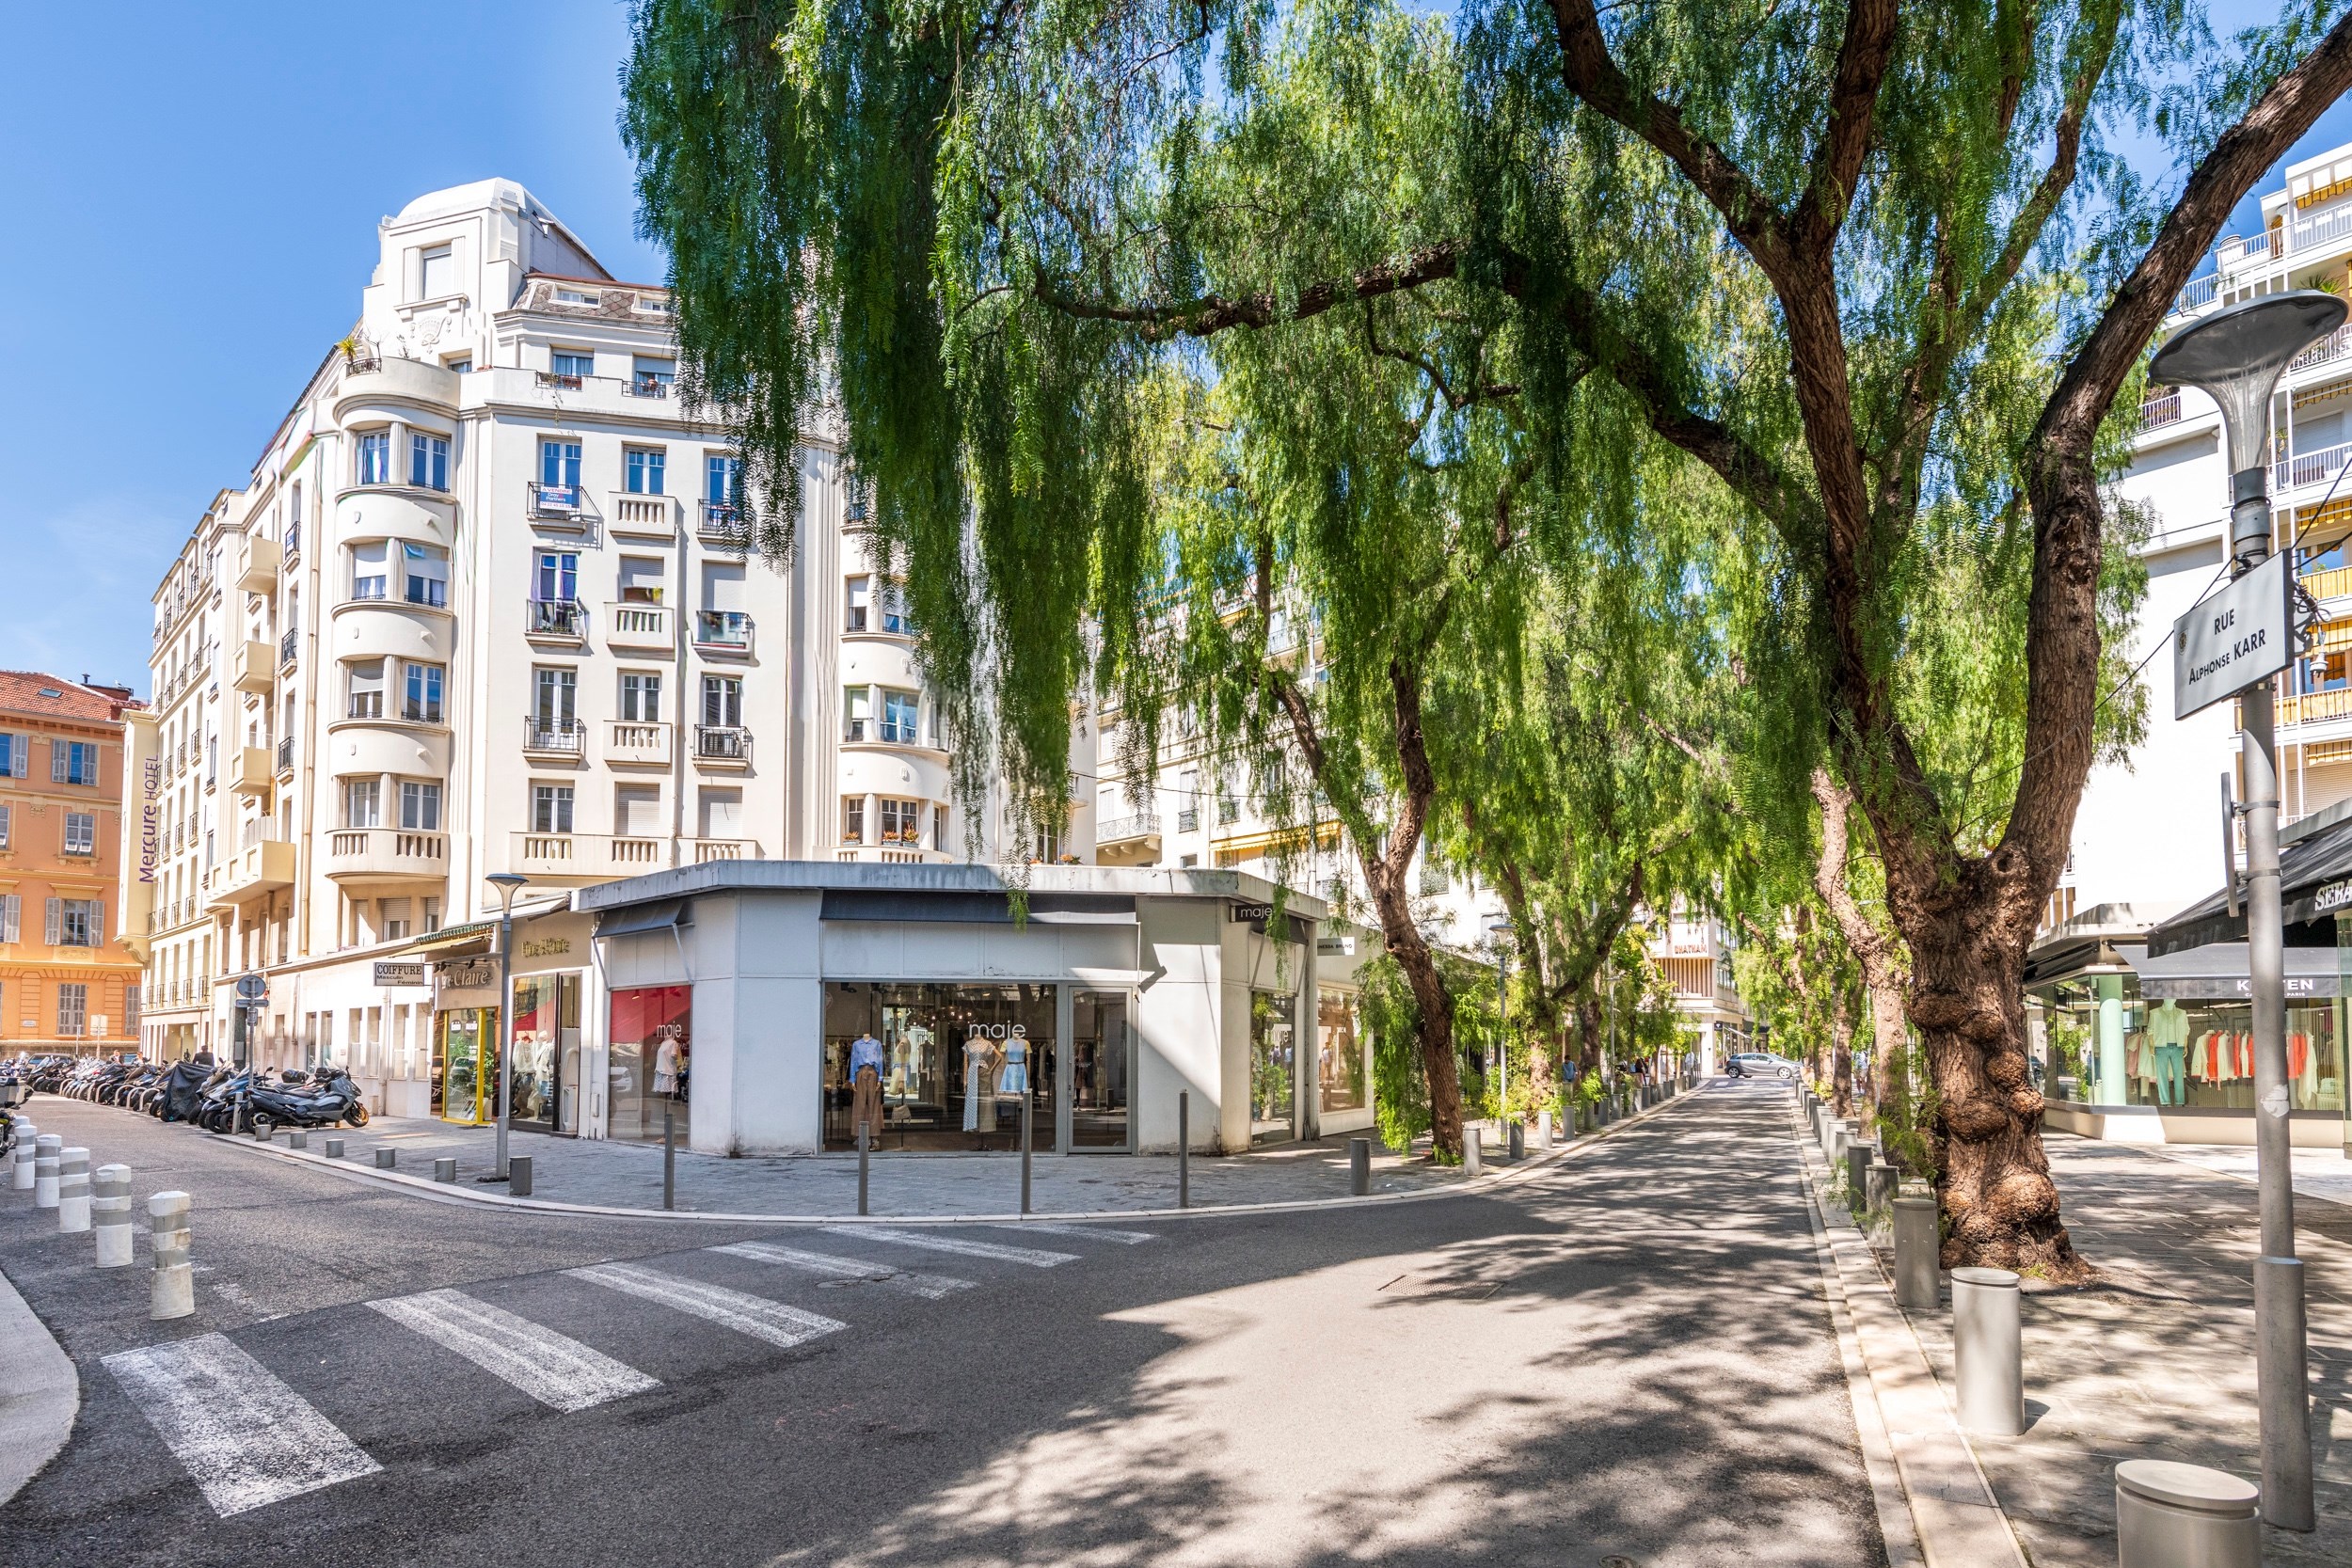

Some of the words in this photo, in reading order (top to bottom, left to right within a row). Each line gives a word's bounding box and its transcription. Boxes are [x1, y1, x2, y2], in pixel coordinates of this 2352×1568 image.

[2214, 608, 2234, 636] RUE
[2188, 652, 2230, 686] ALPHONSE
[2233, 628, 2266, 661] KARR
[144, 754, 159, 801] HOTEL
[138, 804, 157, 883] Mercure
[1240, 905, 1273, 920] maje
[376, 964, 422, 975] COIFFURE
[657, 1020, 682, 1038] maje
[968, 1019, 1026, 1039] maje
